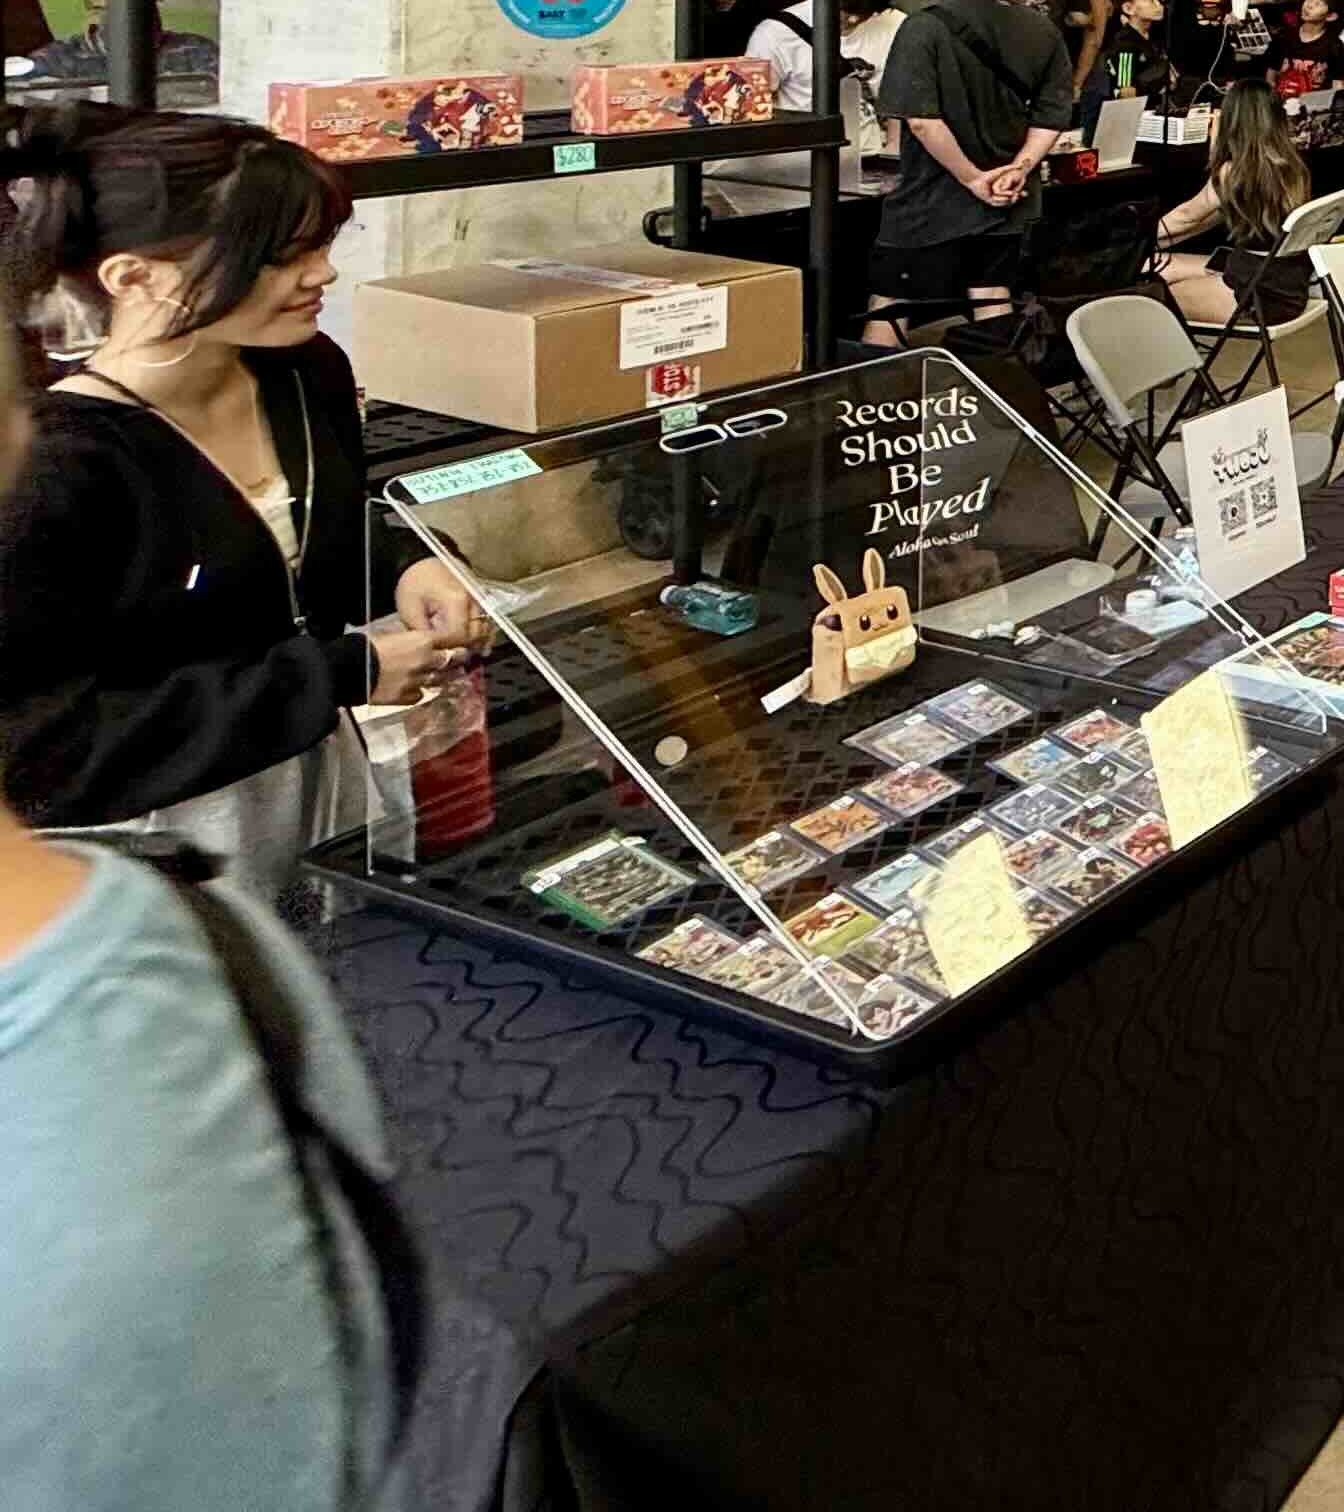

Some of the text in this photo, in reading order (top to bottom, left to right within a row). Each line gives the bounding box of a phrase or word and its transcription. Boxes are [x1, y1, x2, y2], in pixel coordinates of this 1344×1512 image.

[559, 145, 592, 166] $280
[836, 387, 979, 428] Records
[840, 419, 977, 466] Should
[888, 463, 942, 495] Be
[864, 476, 991, 536] Played
[888, 535, 931, 559] Aloha
[950, 524, 980, 545] Soul
